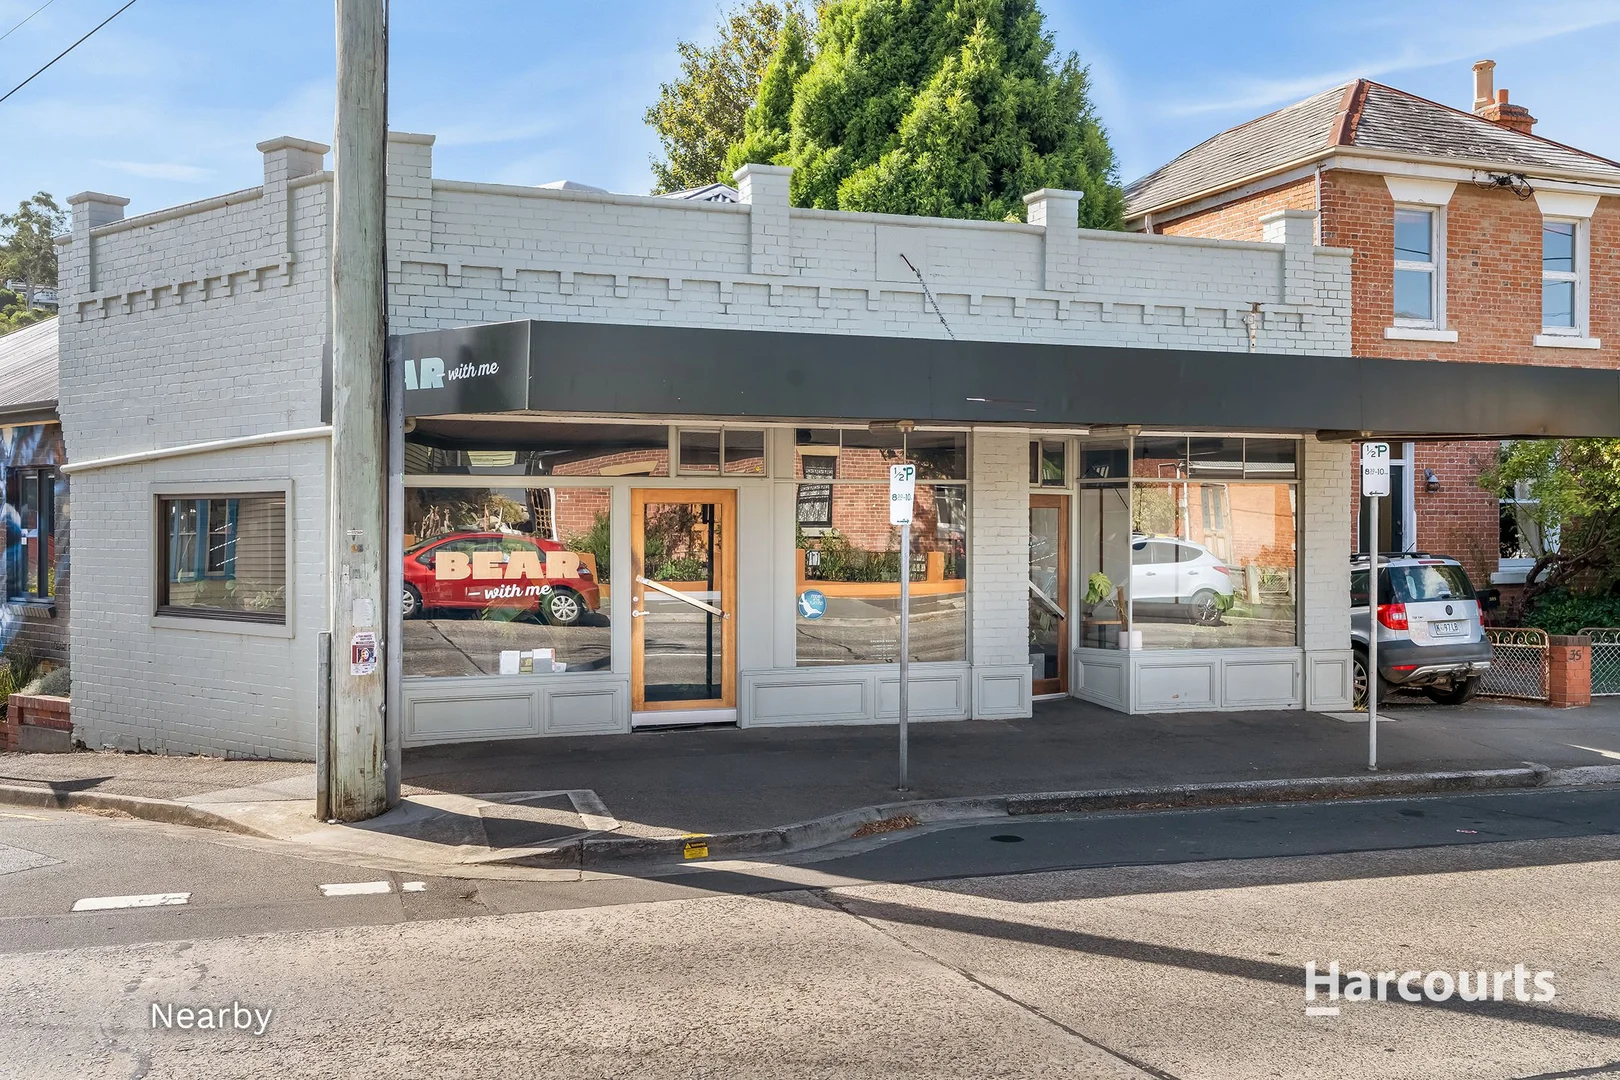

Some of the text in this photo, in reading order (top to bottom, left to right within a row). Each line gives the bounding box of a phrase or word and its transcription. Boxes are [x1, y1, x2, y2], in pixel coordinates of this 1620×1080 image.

[448, 362, 477, 380] with
[478, 362, 499, 376] me
[435, 551, 580, 580] BEAR
[484, 584, 552, 599] with me
